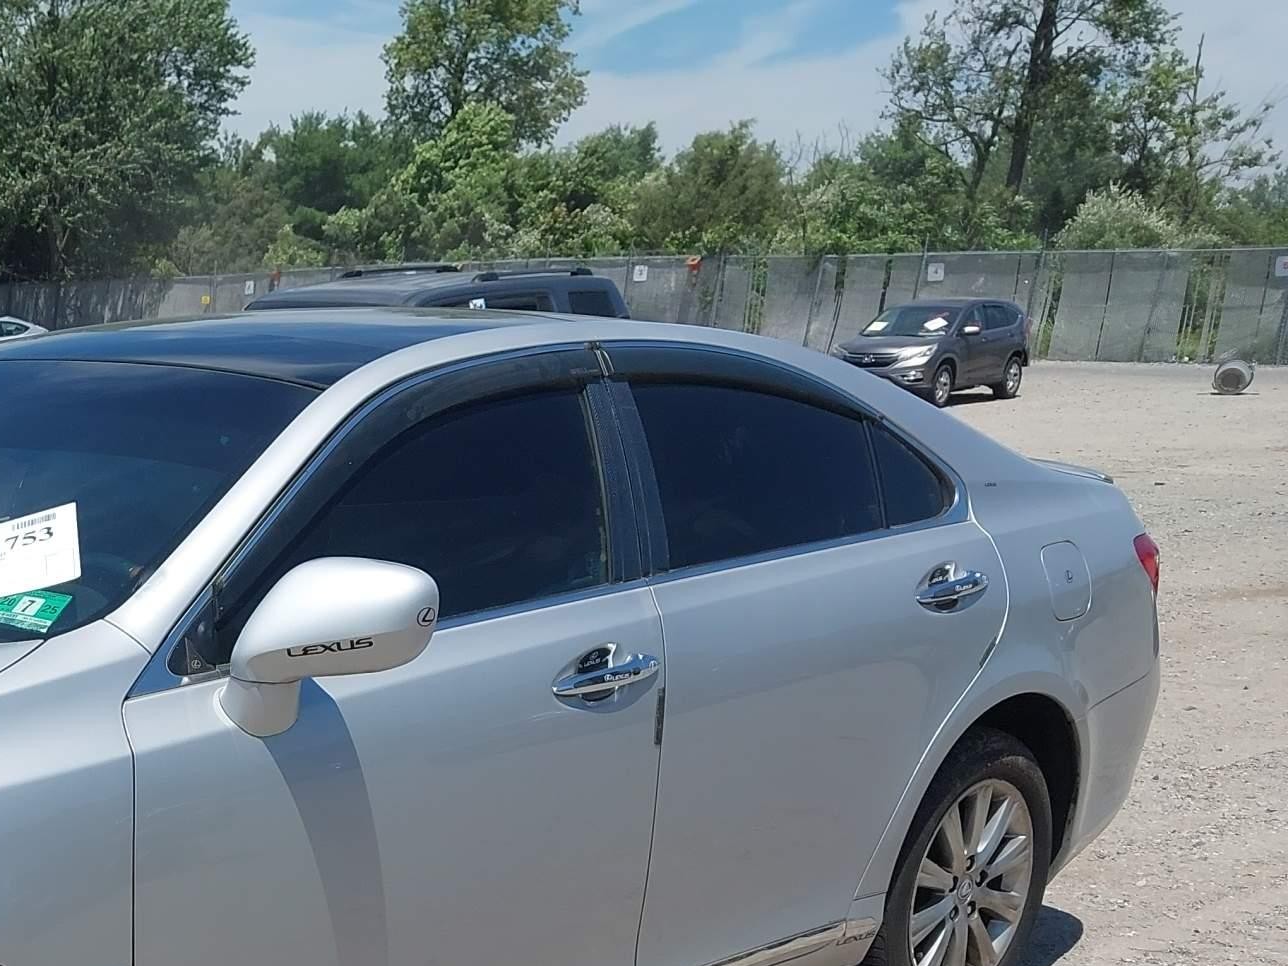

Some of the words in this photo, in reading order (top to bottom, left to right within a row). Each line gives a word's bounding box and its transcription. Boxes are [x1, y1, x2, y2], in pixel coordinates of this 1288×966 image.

[0, 597, 17, 607] 20
[21, 599, 37, 613] 7
[39, 604, 59, 615] 25
[287, 637, 374, 657] LEXUS
